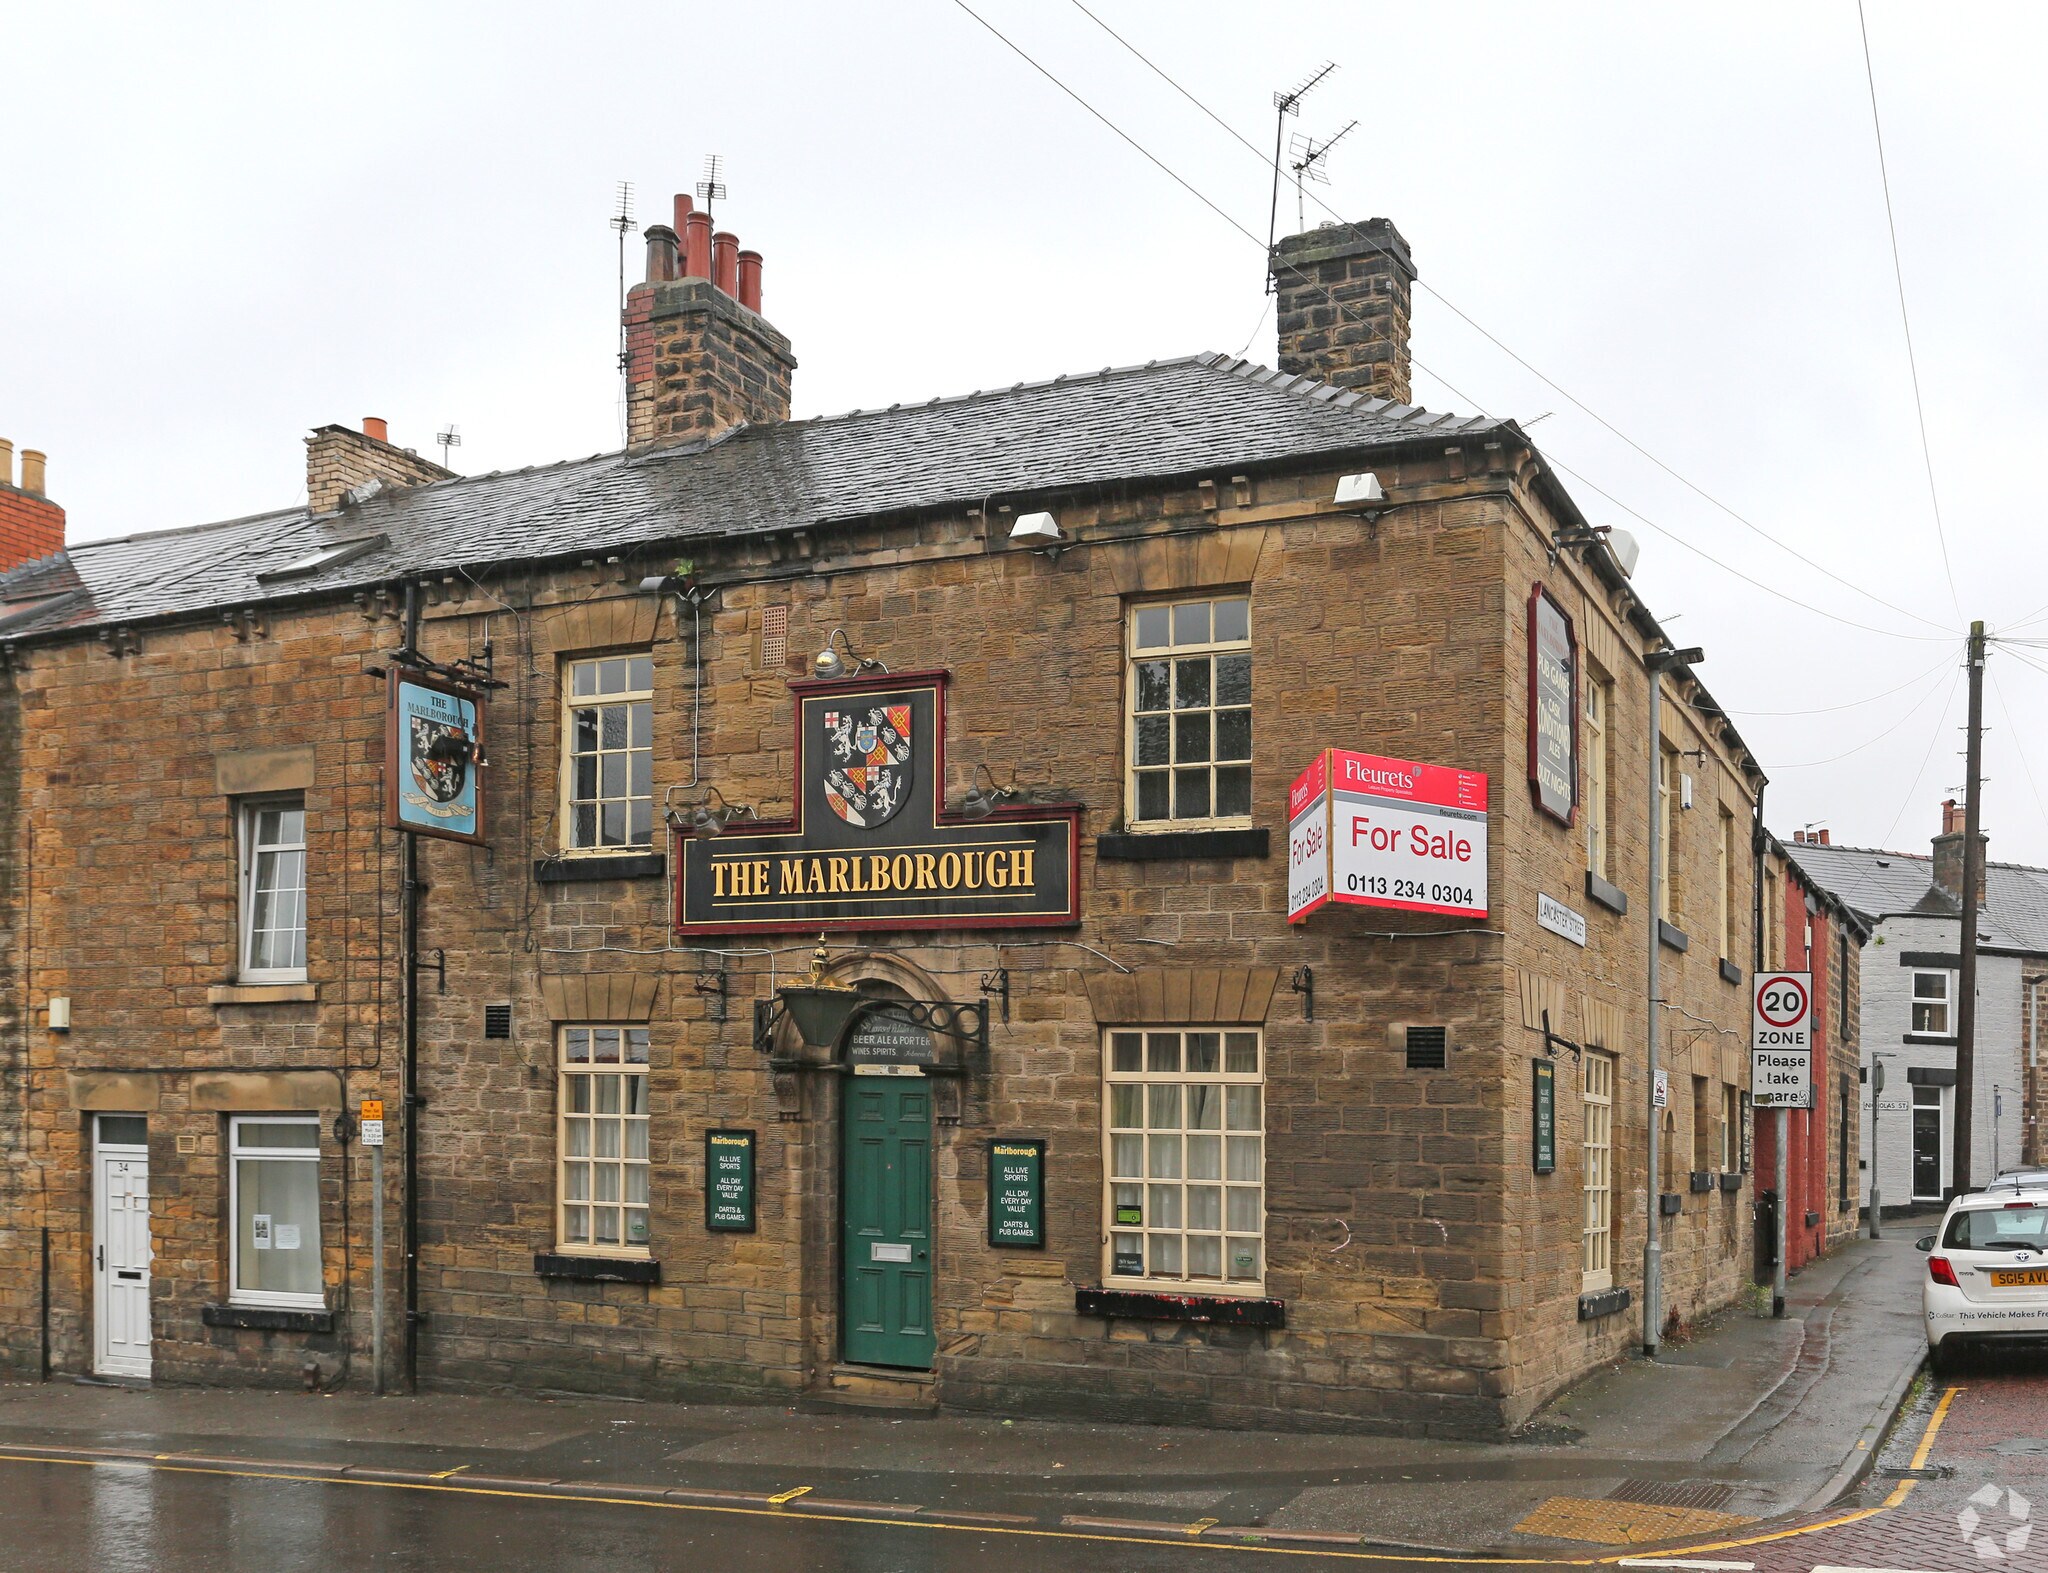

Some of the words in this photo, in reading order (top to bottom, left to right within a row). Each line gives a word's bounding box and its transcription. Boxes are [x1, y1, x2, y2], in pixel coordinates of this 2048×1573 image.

[1538, 652, 1550, 679] PUB
[1550, 669, 1570, 698] GAMES
[430, 696, 447, 710] THE
[1548, 698, 1561, 720] CASK
[407, 701, 469, 728] MARLBOROUGH
[1548, 740, 1561, 760] ALES
[1345, 759, 1414, 789] Fleurets
[1537, 761, 1551, 787] QUIZ
[1551, 770, 1571, 801] NIGHTS
[1291, 783, 1308, 809] Fleurets
[1439, 809, 1477, 821] fleurets.com
[1292, 838, 1305, 869] For
[1306, 821, 1323, 859] Sale
[1352, 816, 1401, 852] For
[1410, 825, 1472, 862] Sale
[710, 860, 770, 897] THE
[778, 849, 1036, 895] MARLBOROUGH
[1291, 891, 1302, 911] 0113
[1302, 883, 1311, 904] 234
[1312, 875, 1324, 900] 0304
[1347, 873, 1388, 895] 0113
[1394, 879, 1426, 899] 234
[1431, 884, 1473, 905] 0304
[1540, 900, 1568, 929] LANCASTER
[1569, 917, 1584, 938] STREET
[1765, 991, 1800, 1012] 20
[877, 1035, 891, 1045] ALE
[892, 1036, 898, 1045] &
[899, 1036, 931, 1046] PORTER
[1758, 1032, 1805, 1045] ZONE
[1757, 1054, 1806, 1067] Please
[1767, 1072, 1799, 1085] take
[711, 1136, 749, 1147] Marlborough
[993, 1146, 1037, 1158] Marlborough
[729, 1155, 741, 1163] LIVE
[118, 1162, 129, 1172] 34
[719, 1162, 741, 1170] SPORTS
[1003, 1166, 1015, 1174] ALL
[1015, 1166, 1029, 1174] LIVE
[730, 1177, 741, 1185] DAY
[1004, 1174, 1028, 1182] SPORTS
[721, 1191, 738, 1199] VALUE
[1000, 1197, 1019, 1205] EVERY
[1007, 1205, 1026, 1213] VALUE
[726, 1213, 746, 1221] GAMES
[1003, 1220, 1023, 1228] DARTS
[1024, 1221, 1029, 1229] &
[999, 1228, 1011, 1236] PUB
[1012, 1228, 1034, 1237] GAMES
[1998, 1272, 2025, 1284] SG15
[2008, 1310, 2035, 1318] Makes
